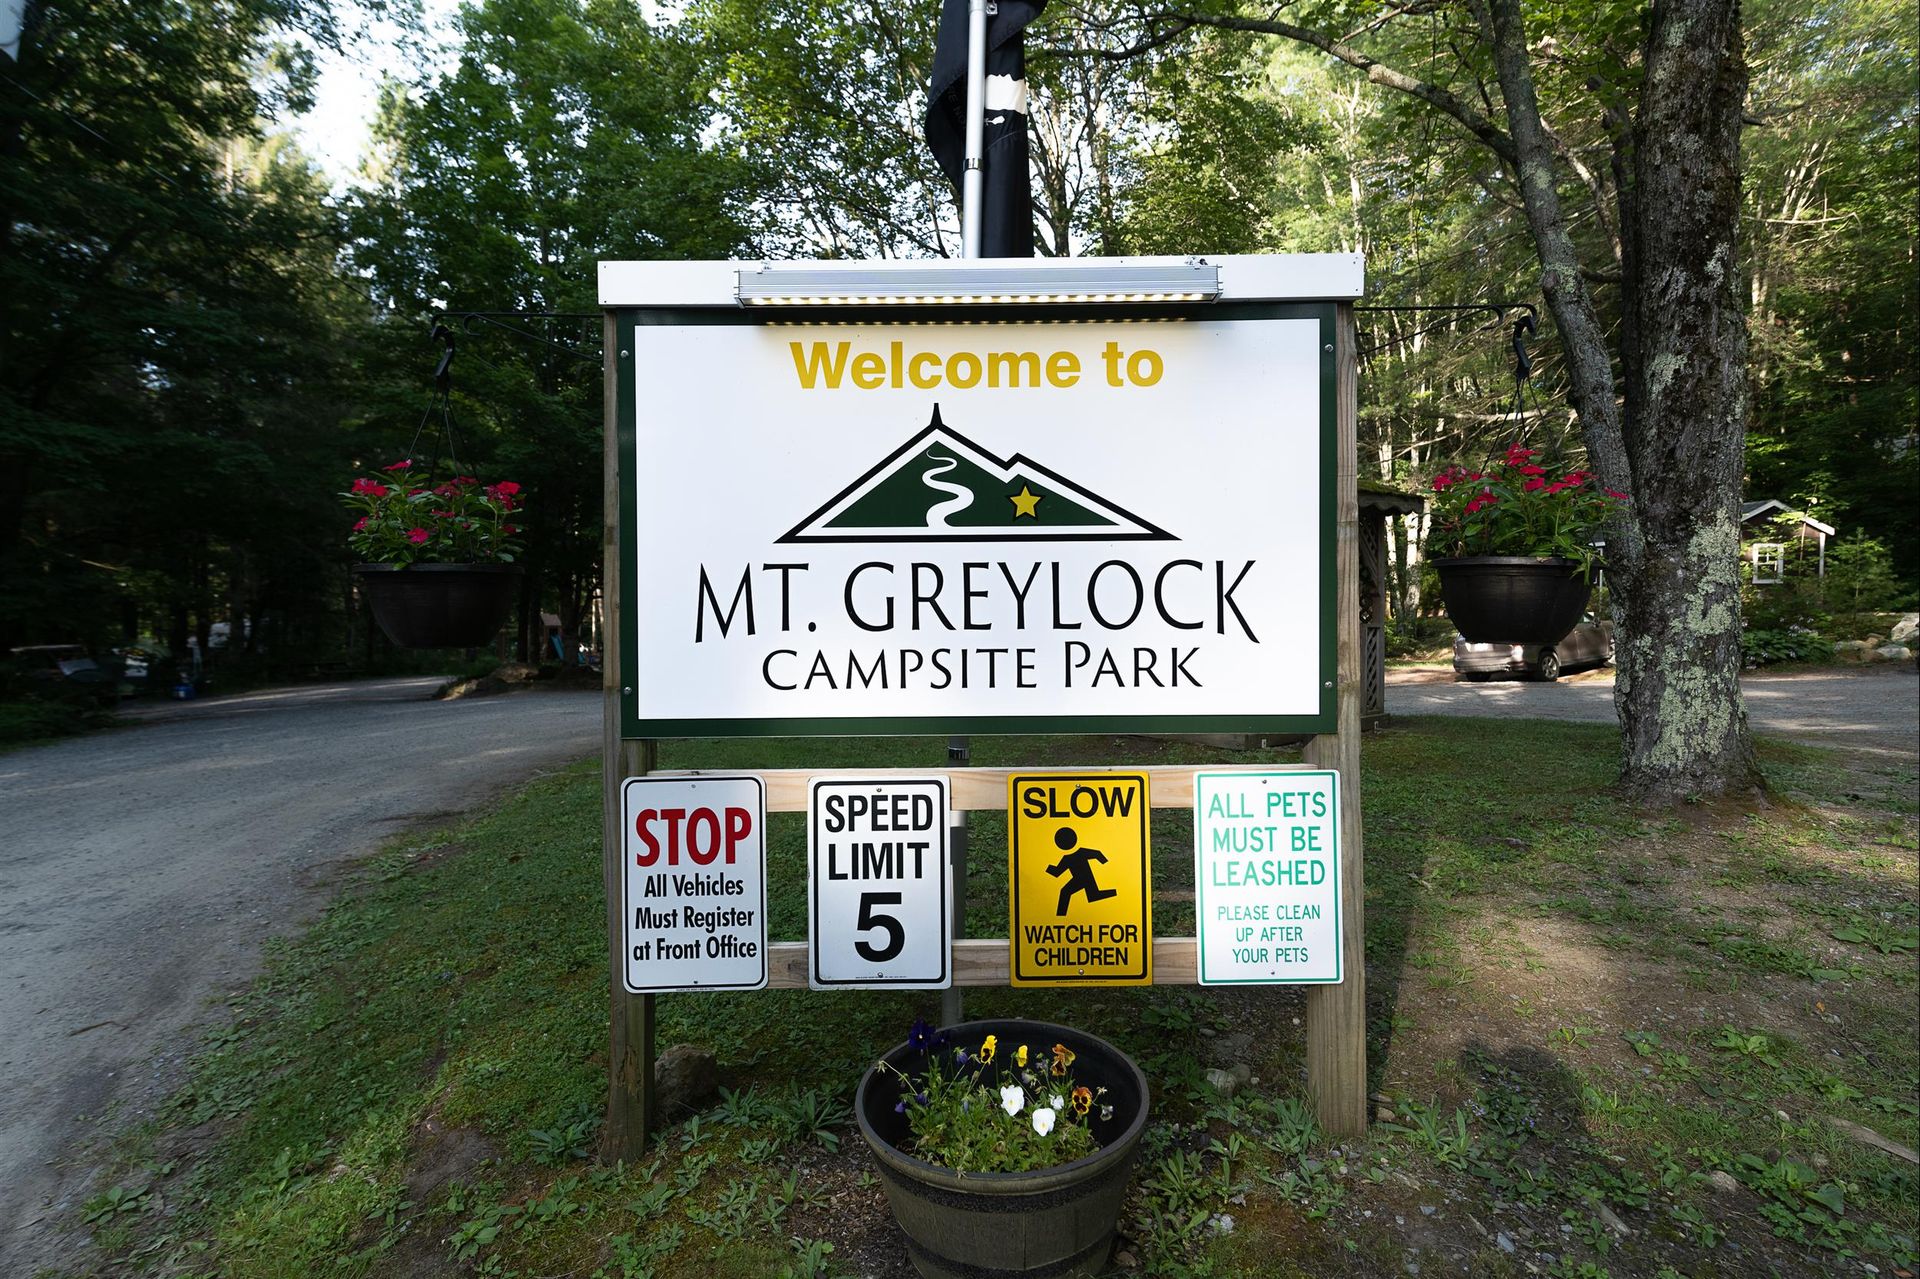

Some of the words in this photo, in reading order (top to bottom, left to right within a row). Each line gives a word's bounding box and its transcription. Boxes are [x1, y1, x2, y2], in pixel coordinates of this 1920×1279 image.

[789, 341, 1080, 389] Welcome
[1102, 342, 1163, 387] to
[696, 563, 816, 643] MT.
[844, 560, 1260, 643] GREYLOCK
[763, 649, 1037, 690] CAMPSITE
[826, 795, 932, 832] SPEED
[1023, 787, 1135, 818] SLOW
[1209, 793, 1254, 818] ALL
[1268, 792, 1326, 817] PETS
[636, 808, 751, 867] STOP
[1214, 827, 1277, 852] MUST
[1291, 826, 1321, 851] BE
[829, 843, 929, 880] LIMIT
[1214, 860, 1325, 886] LEASHED
[644, 874, 666, 897] All
[672, 872, 743, 896] Vehicles
[636, 907, 678, 929] Must
[684, 906, 754, 933] Register
[1219, 905, 1269, 920] PLEASE
[1277, 905, 1320, 920] CLEAN
[855, 892, 905, 962] 5
[1025, 925, 1092, 944] WATCH
[1099, 925, 1137, 943] FOR
[1237, 927, 1253, 942] UP
[1261, 927, 1302, 941] AFTER
[634, 941, 651, 961] at
[657, 938, 701, 960] Front
[707, 935, 757, 958] Office
[1035, 948, 1128, 966] CHILDREN
[1233, 948, 1268, 963] YOUR
[1276, 948, 1308, 962] PETS
